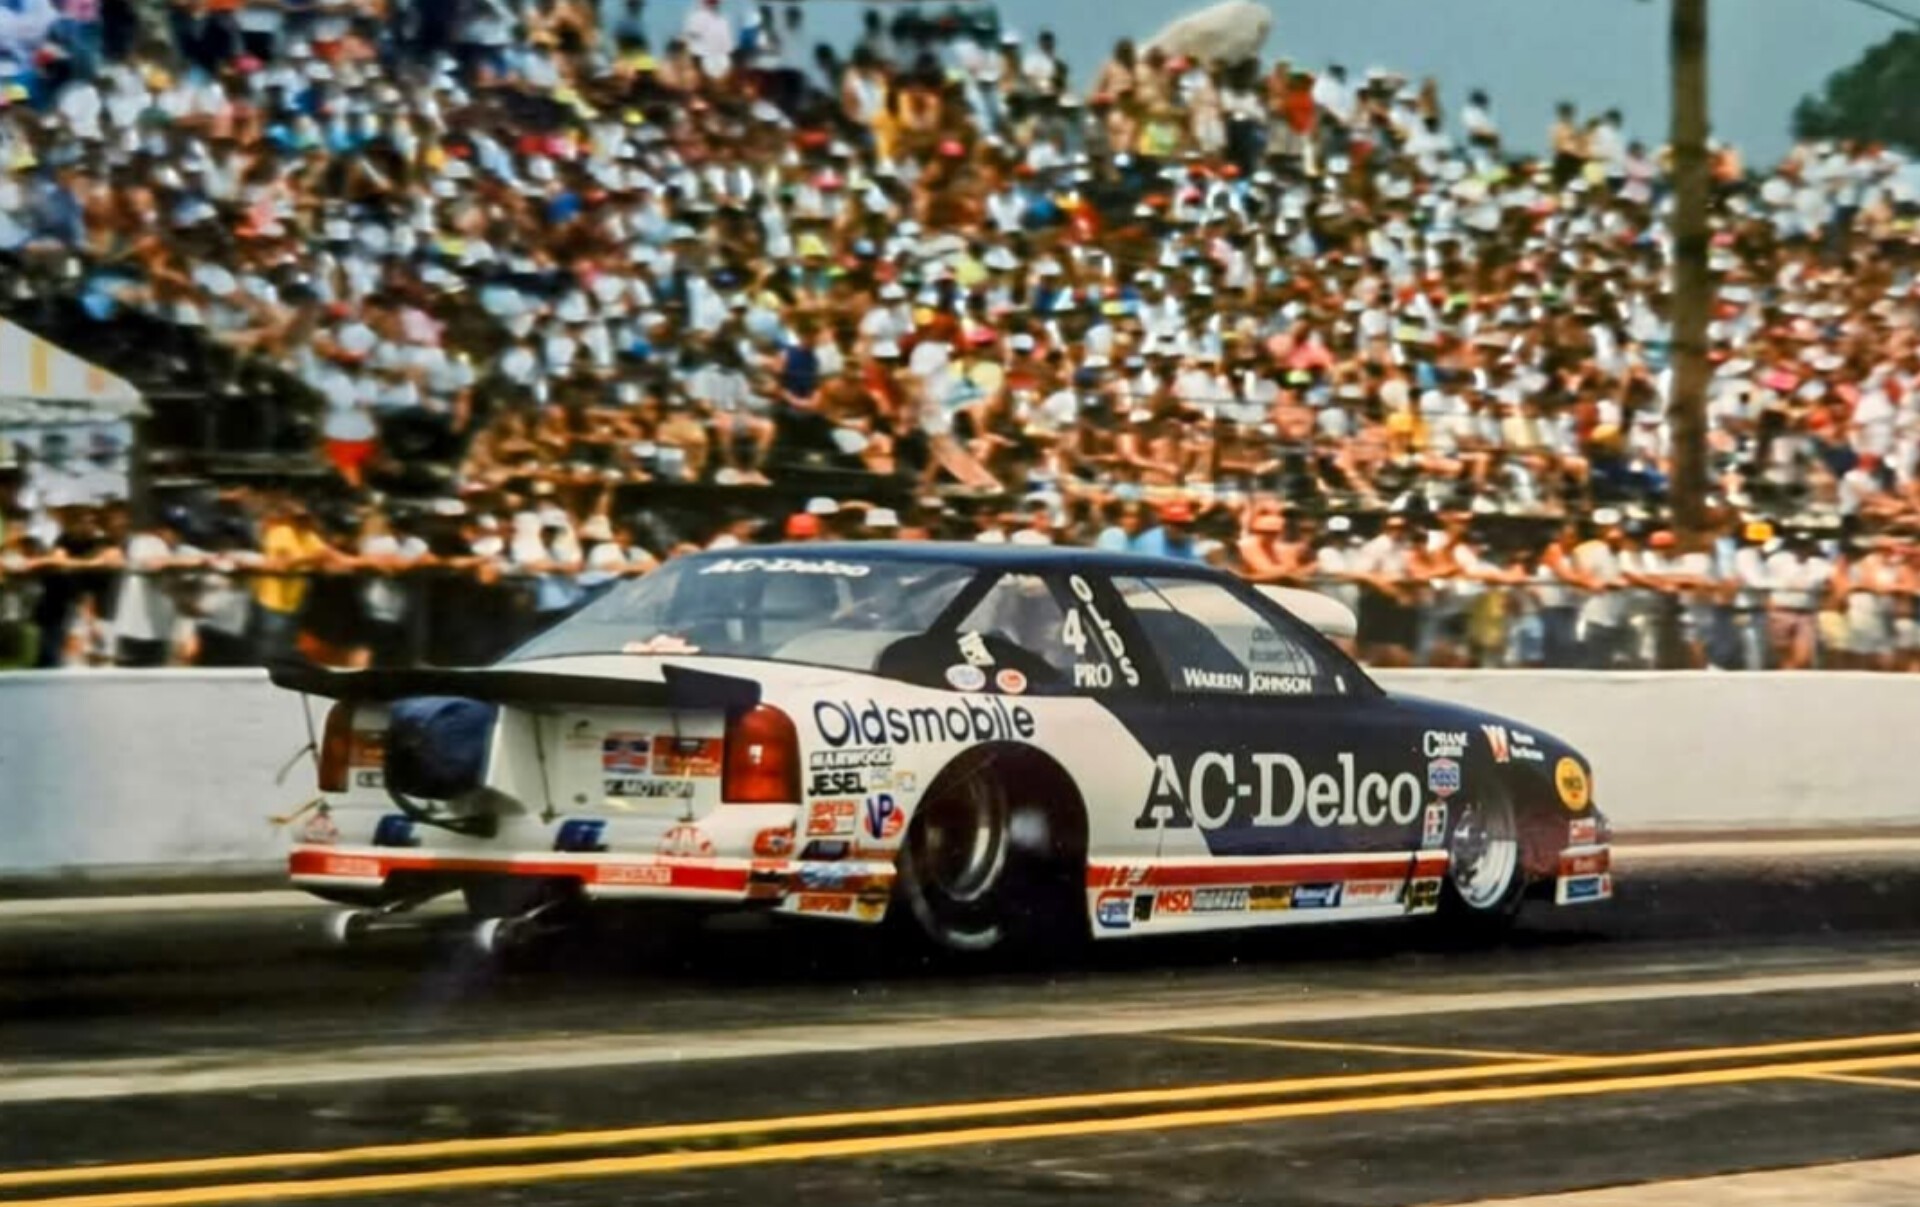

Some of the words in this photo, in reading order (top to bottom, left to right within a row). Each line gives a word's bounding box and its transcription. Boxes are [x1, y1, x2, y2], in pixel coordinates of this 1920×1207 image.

[1063, 608, 1087, 655] 4
[1069, 574, 1139, 686] OLDS
[1074, 663, 1113, 687] PRO
[1183, 668, 1243, 689] WARREN
[1249, 671, 1312, 693] JOHNSON
[813, 697, 1034, 747] Oldsmobile
[808, 772, 867, 796] JESEL
[1135, 752, 1421, 830] AC-Delco
[866, 793, 894, 839] VP
[1155, 889, 1192, 913] MSD
